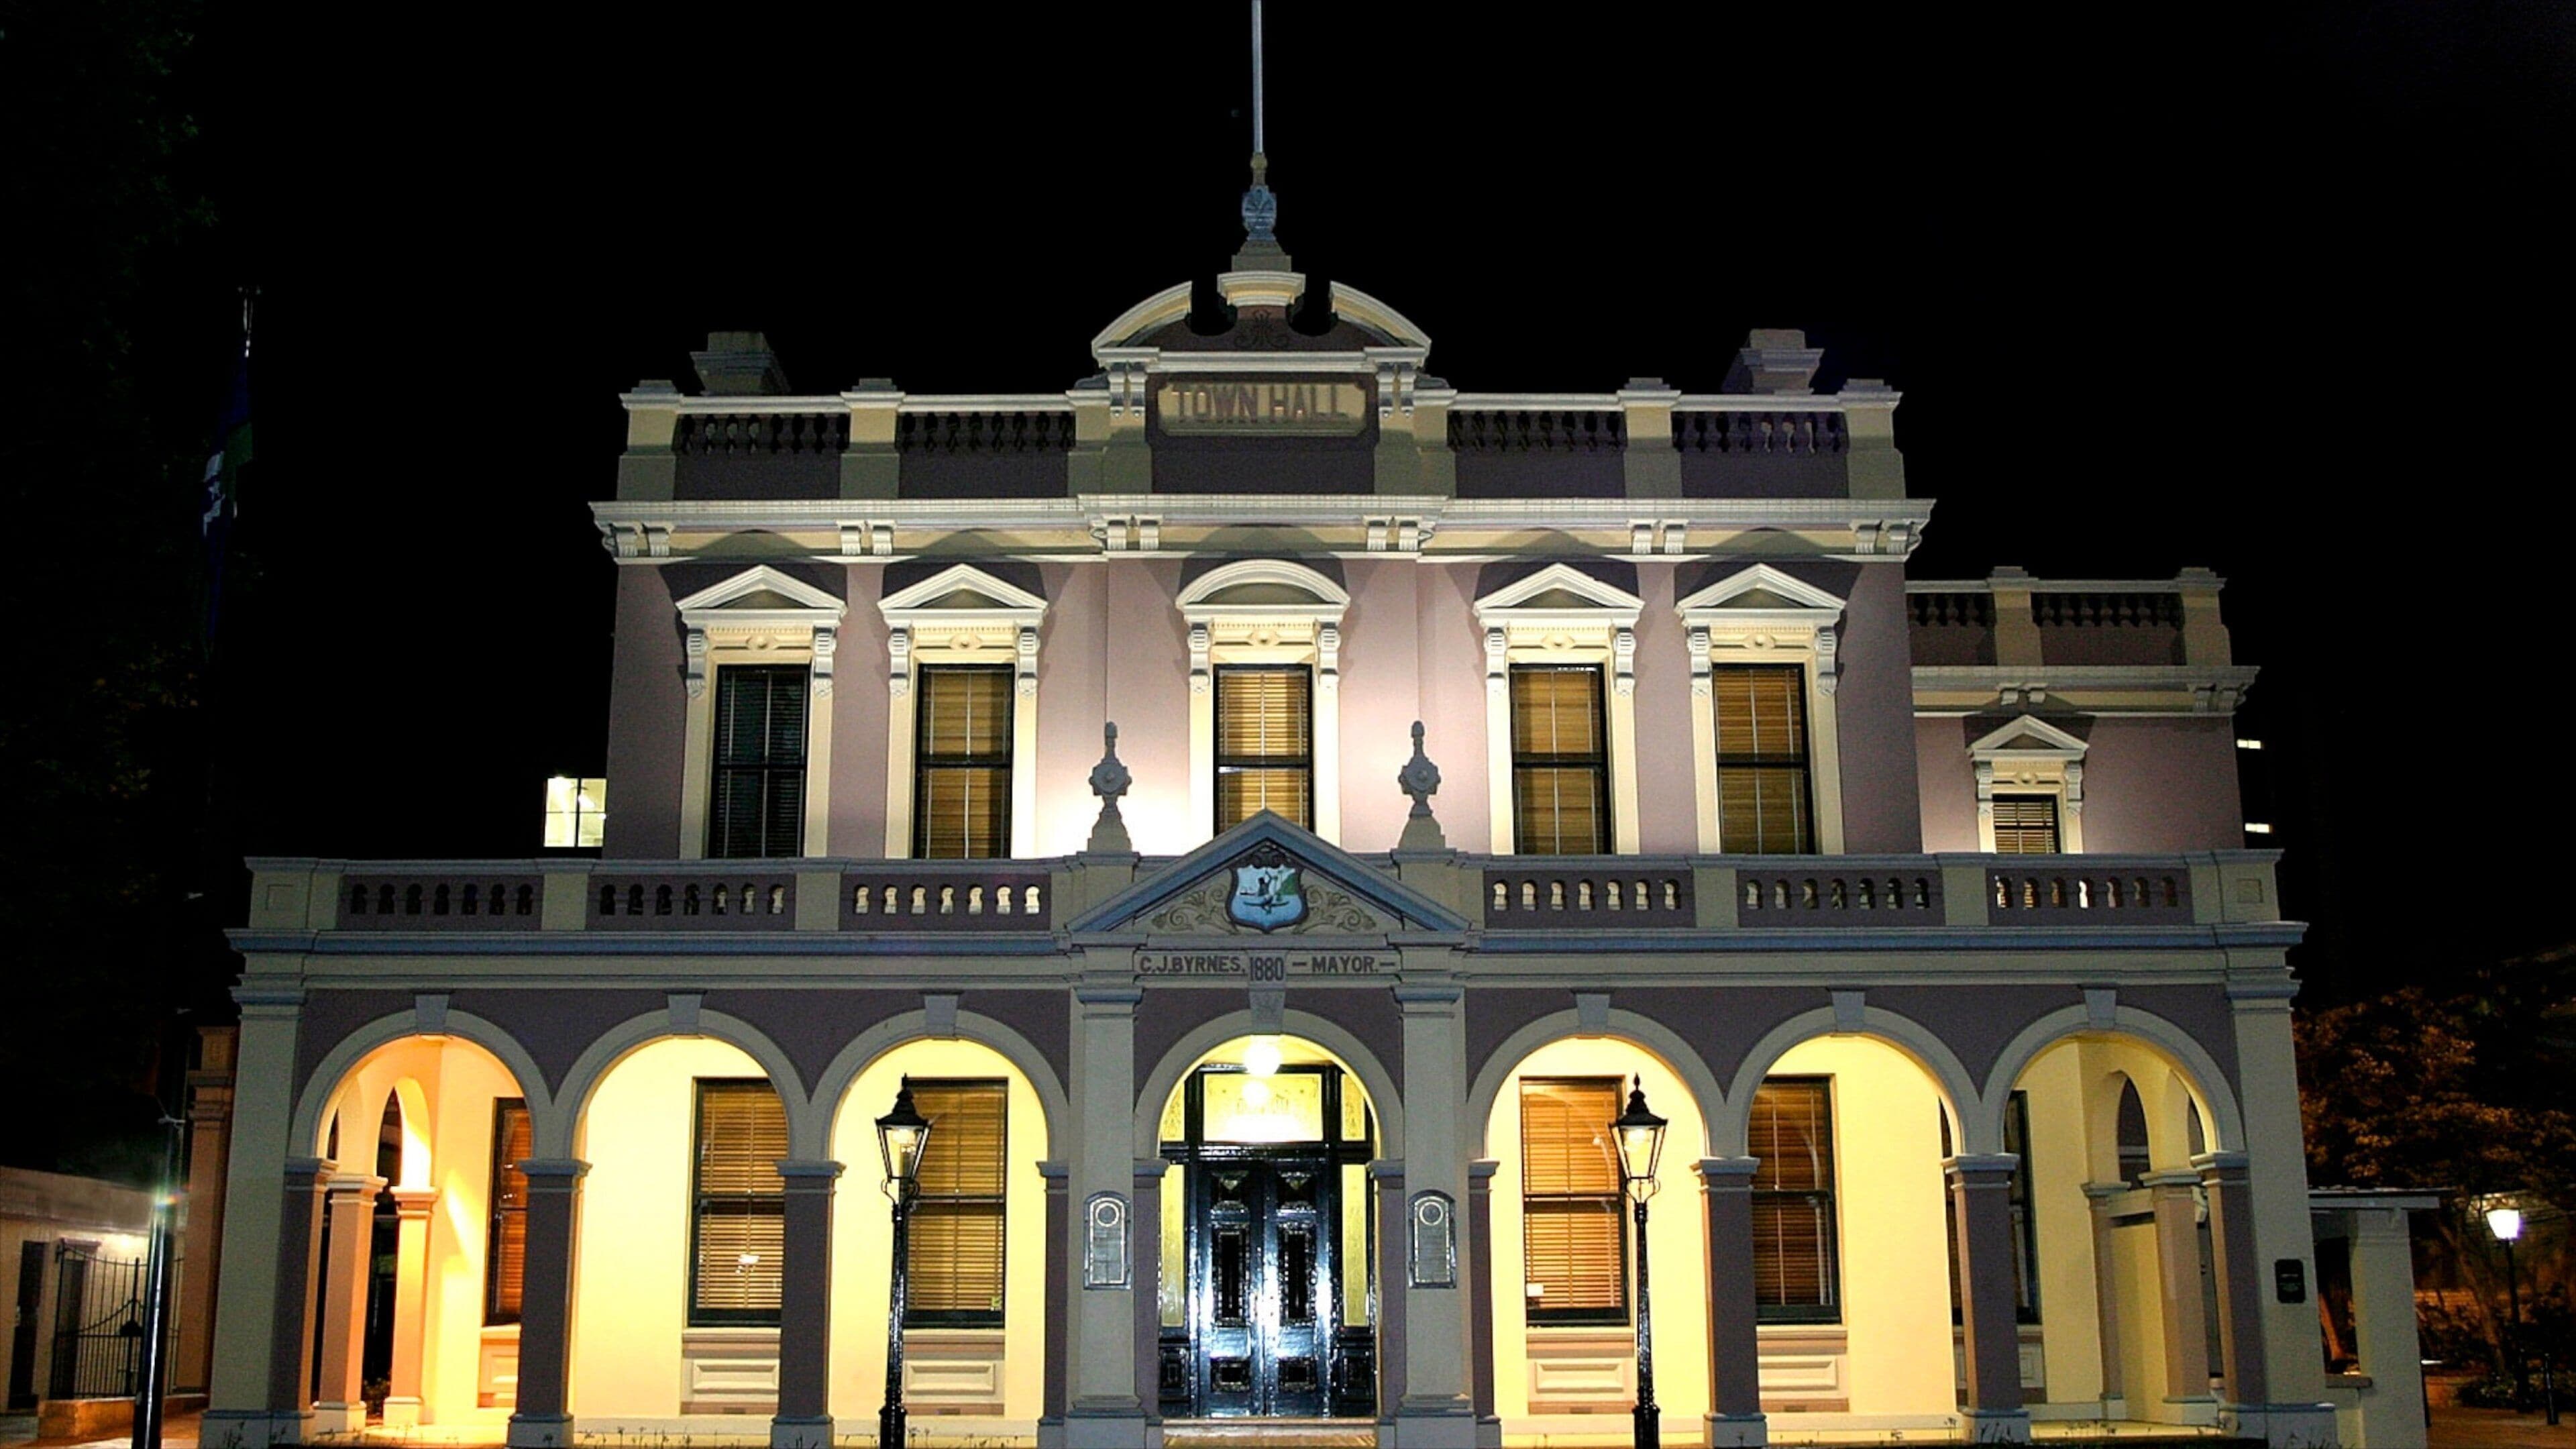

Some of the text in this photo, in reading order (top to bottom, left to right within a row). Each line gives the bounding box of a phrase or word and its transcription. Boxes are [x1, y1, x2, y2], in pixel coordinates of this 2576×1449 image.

[1171, 384, 1349, 423] TOWN HALL
[1249, 957, 1284, 981] 1880
